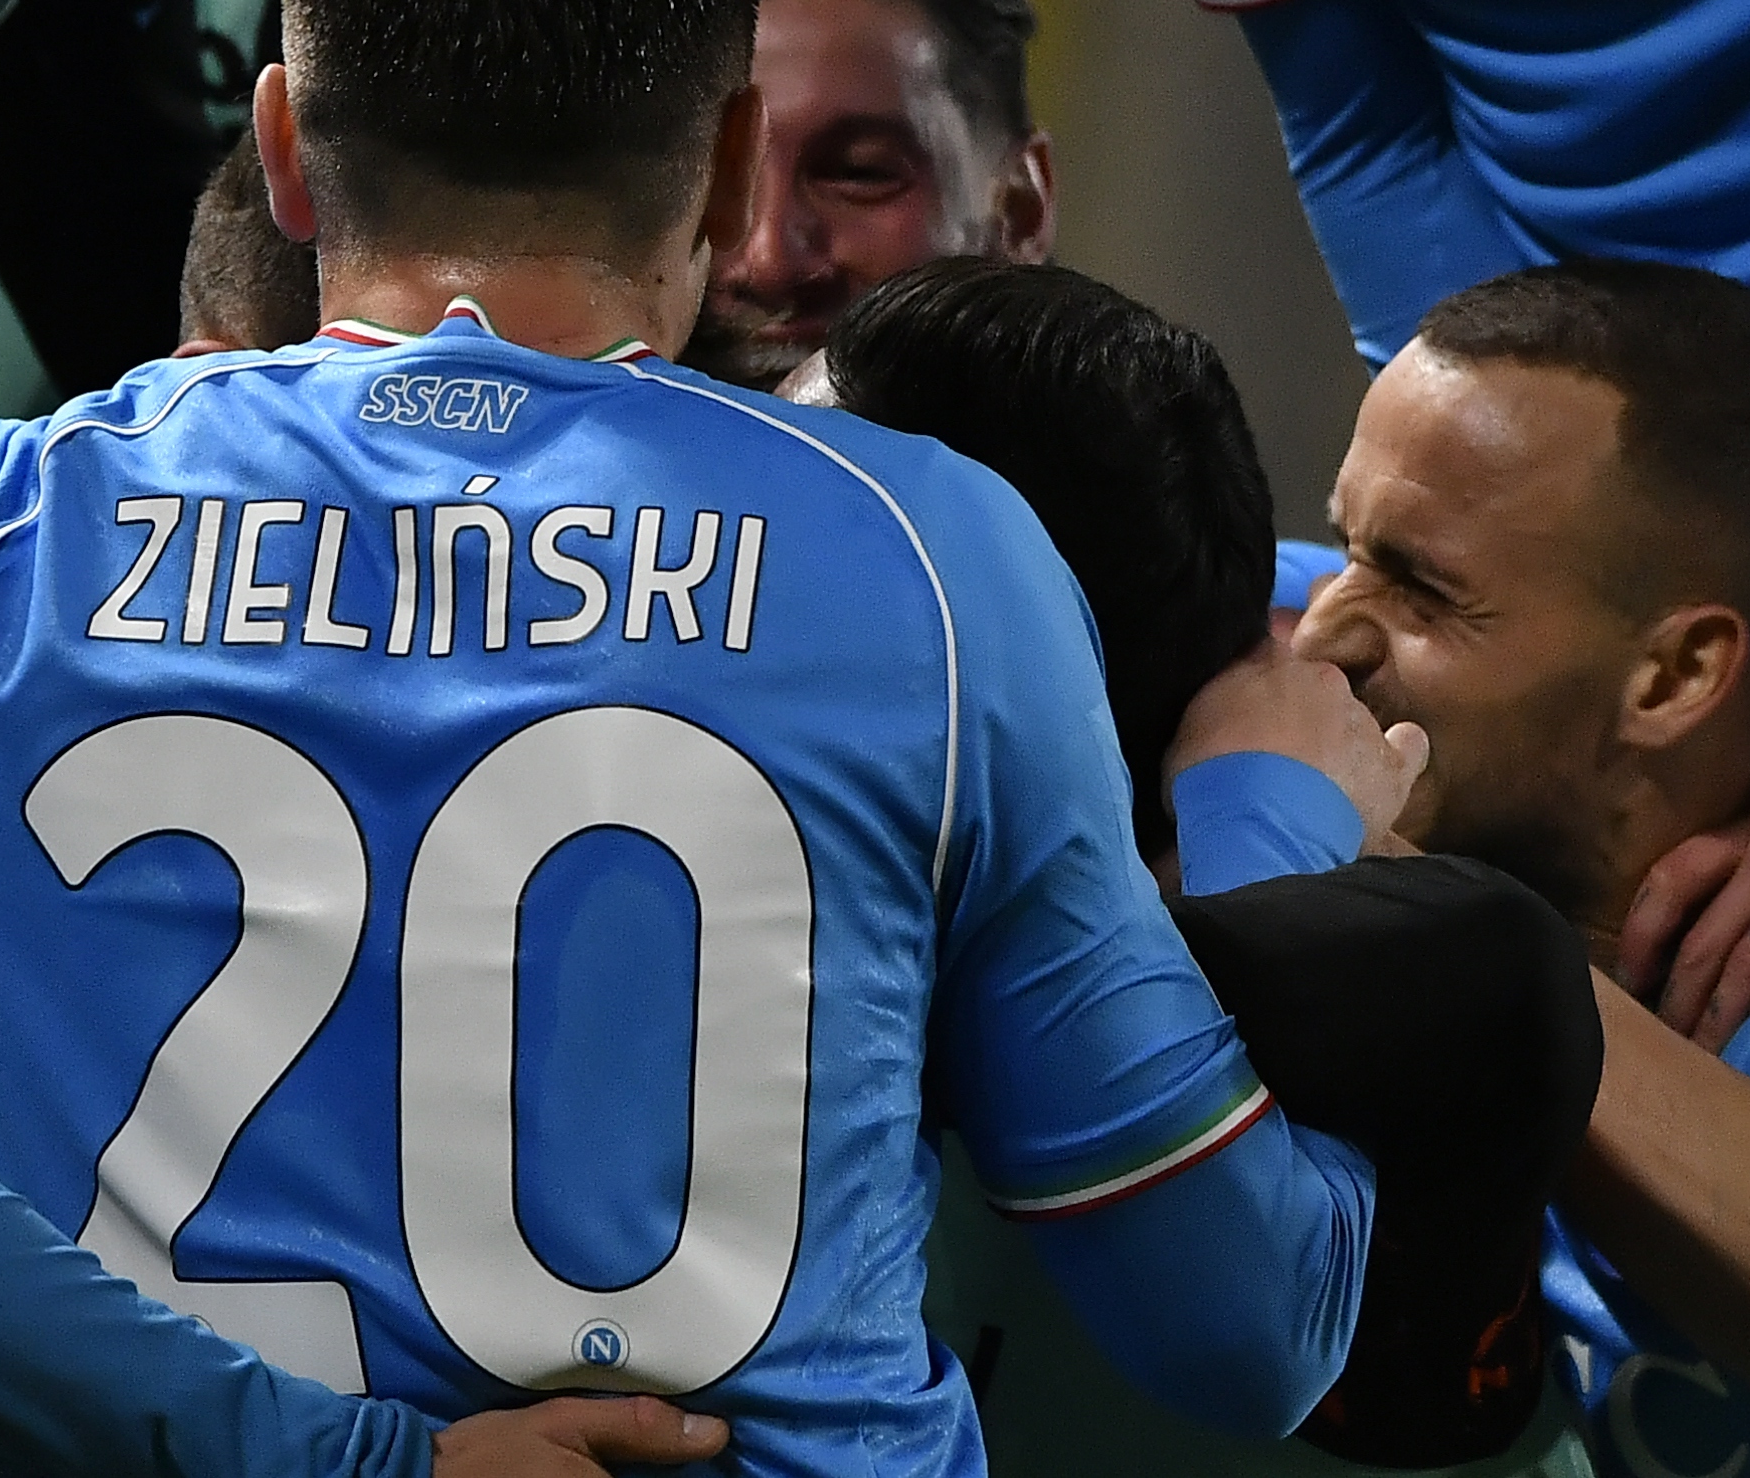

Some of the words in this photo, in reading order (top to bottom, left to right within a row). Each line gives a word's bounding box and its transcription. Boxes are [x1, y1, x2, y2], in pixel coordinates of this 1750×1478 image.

[359, 374, 529, 434] SSCN
[87, 474, 766, 656] ZIELIŃSKI
[23, 705, 817, 1398] 20
